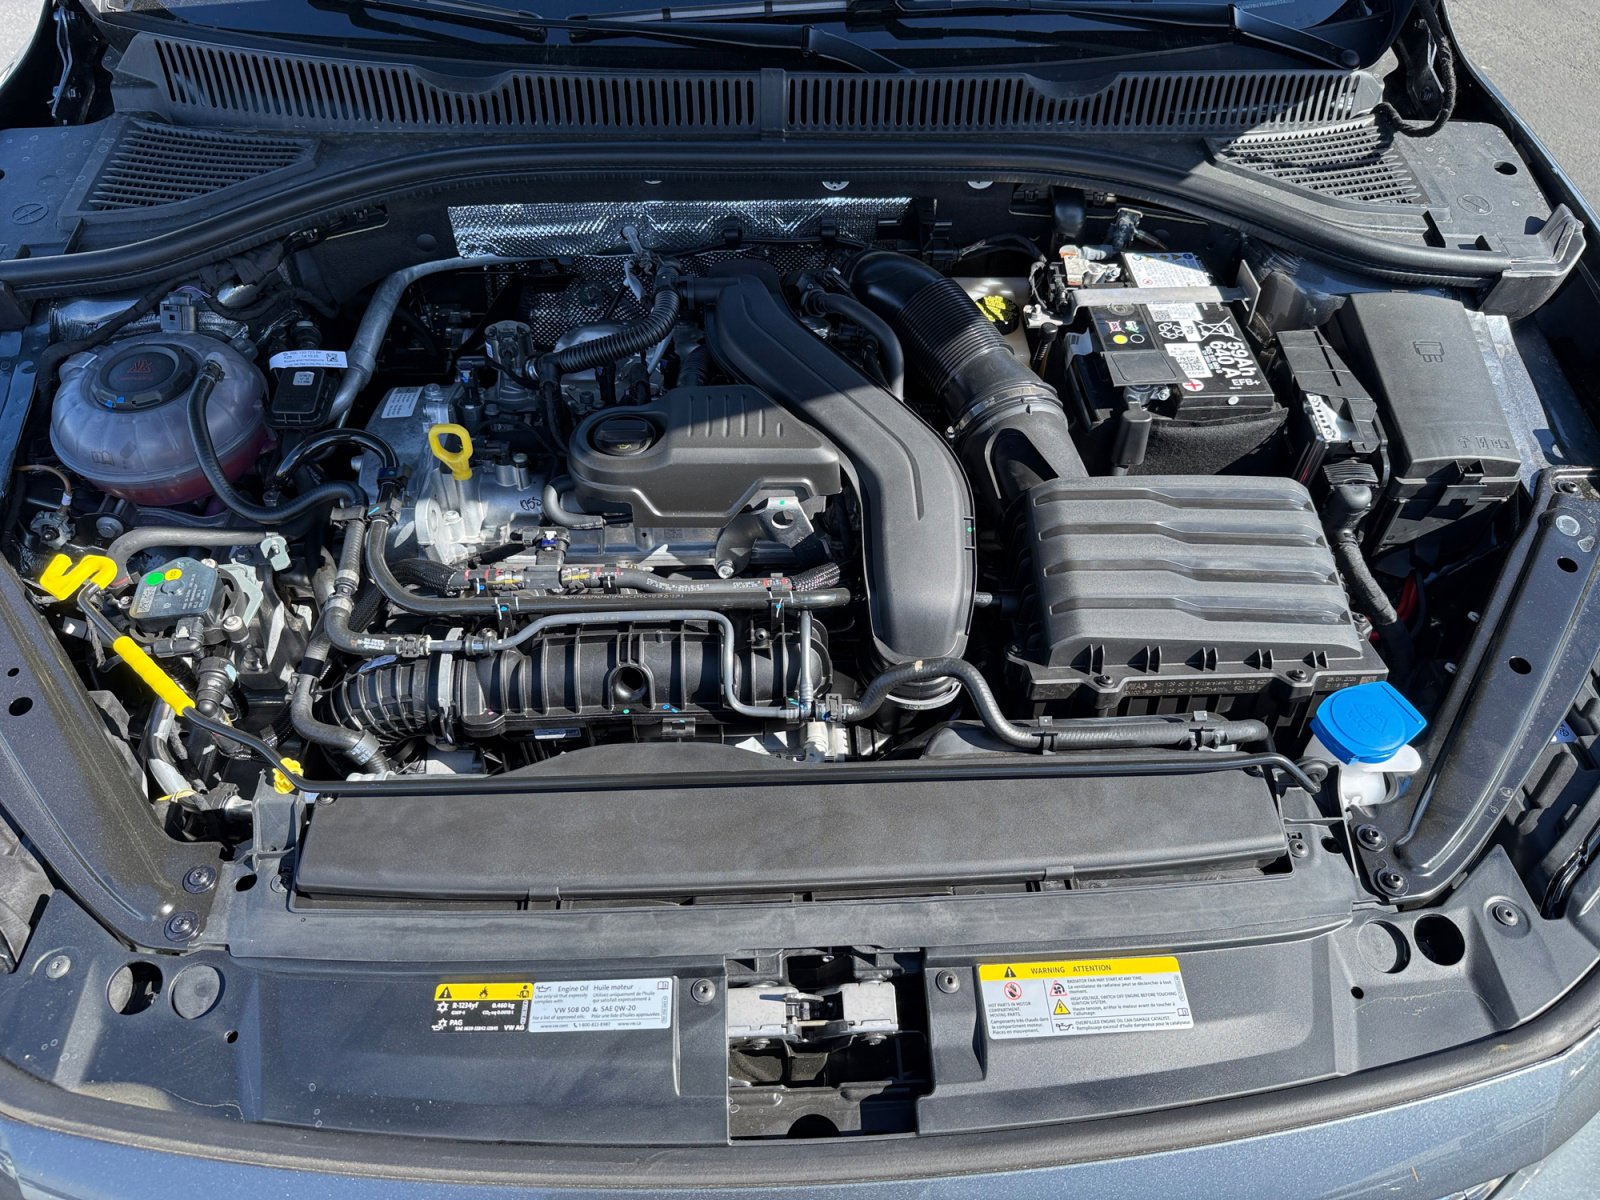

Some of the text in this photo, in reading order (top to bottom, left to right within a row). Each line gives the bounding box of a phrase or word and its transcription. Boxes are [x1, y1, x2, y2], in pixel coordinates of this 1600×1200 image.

[1209, 340, 1235, 365] 640
[1226, 341, 1257, 376] 59Ah
[1221, 367, 1241, 379] A
[1231, 378, 1261, 386] EFB+
[1030, 964, 1112, 975] WARNING ATTENTION
[558, 985, 579, 993] Engine
[452, 1002, 479, 1010] R-1234yf
[614, 1004, 636, 1012] 0W-20
